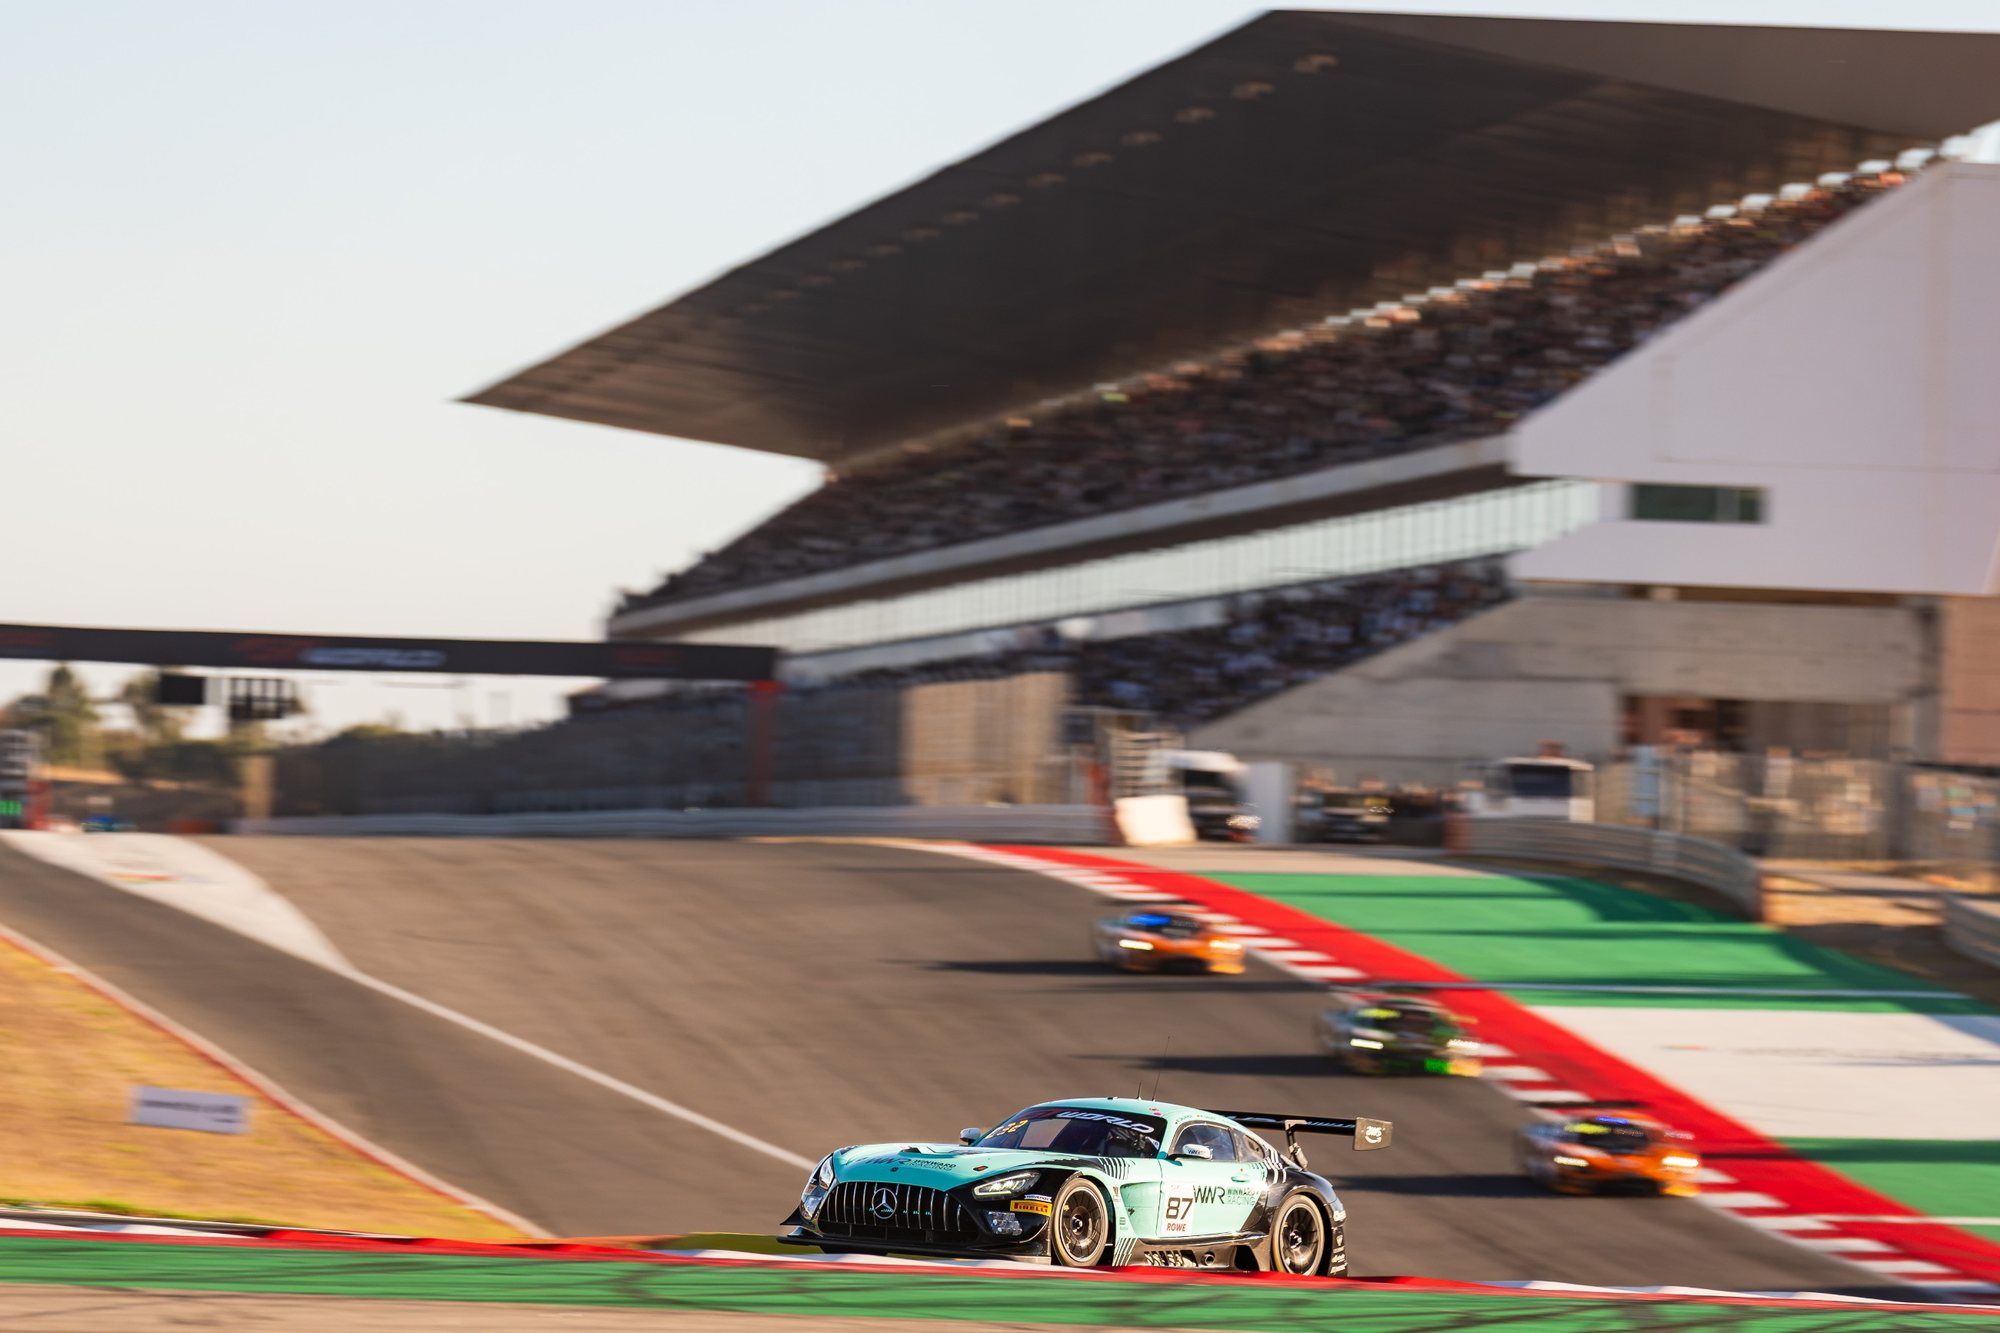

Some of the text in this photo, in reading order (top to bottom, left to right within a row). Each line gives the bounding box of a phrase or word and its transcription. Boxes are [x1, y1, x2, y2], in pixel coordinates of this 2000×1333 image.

[1056, 1111, 1154, 1134] WORLD
[1013, 1201, 1049, 1213] PIRELLI
[1165, 1197, 1194, 1220] 87
[1166, 1222, 1187, 1232] ROWE
